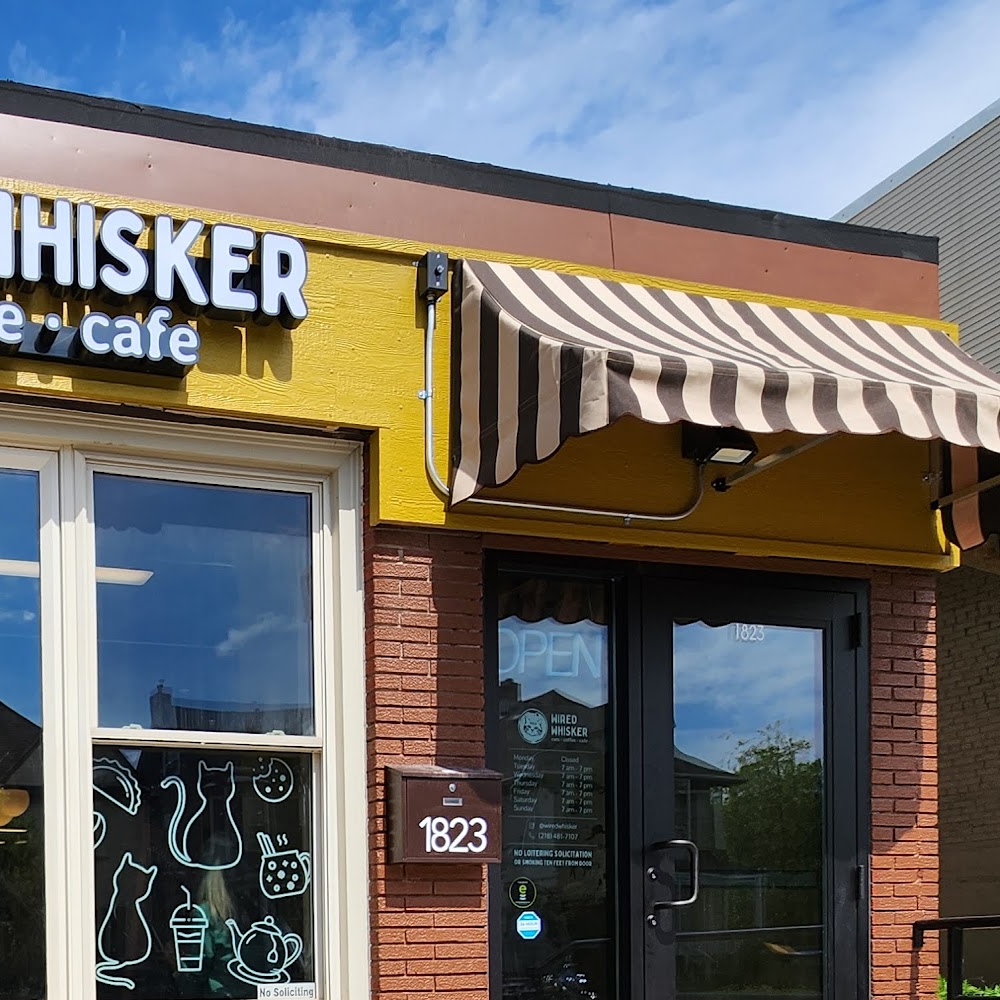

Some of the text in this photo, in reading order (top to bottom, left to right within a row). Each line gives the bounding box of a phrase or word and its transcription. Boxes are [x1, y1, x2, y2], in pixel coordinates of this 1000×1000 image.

[80, 305, 200, 365] cafe
[735, 623, 765, 641] 1823
[551, 713, 577, 724] WIRED
[551, 725, 588, 737] WHISKER
[513, 754, 535, 762] Monday
[514, 788, 530, 796] Friday
[513, 804, 534, 812] Sunday
[419, 816, 487, 852] 1823
[514, 849, 592, 858] NO LOITERING SOLICITATION
[260, 986, 314, 998] No Soliciting
